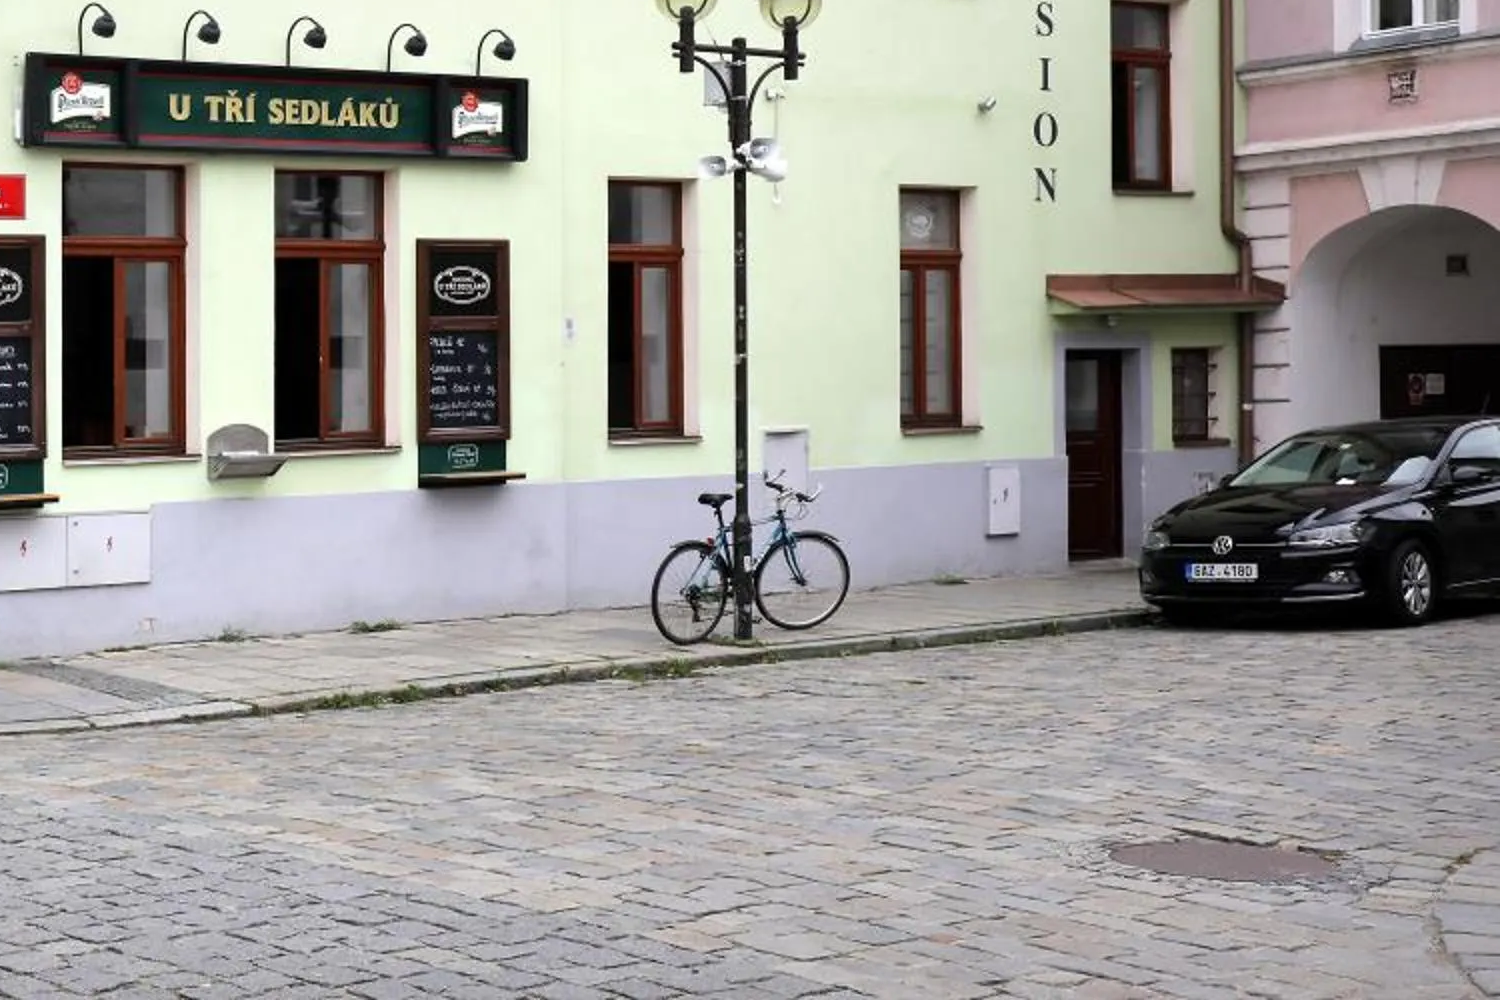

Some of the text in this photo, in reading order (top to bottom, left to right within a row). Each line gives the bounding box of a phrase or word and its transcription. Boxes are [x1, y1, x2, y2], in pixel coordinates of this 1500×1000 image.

[168, 89, 400, 129] U TŘÍ SEDLÁKŮ
[1224, 565, 1252, 577] 4180
